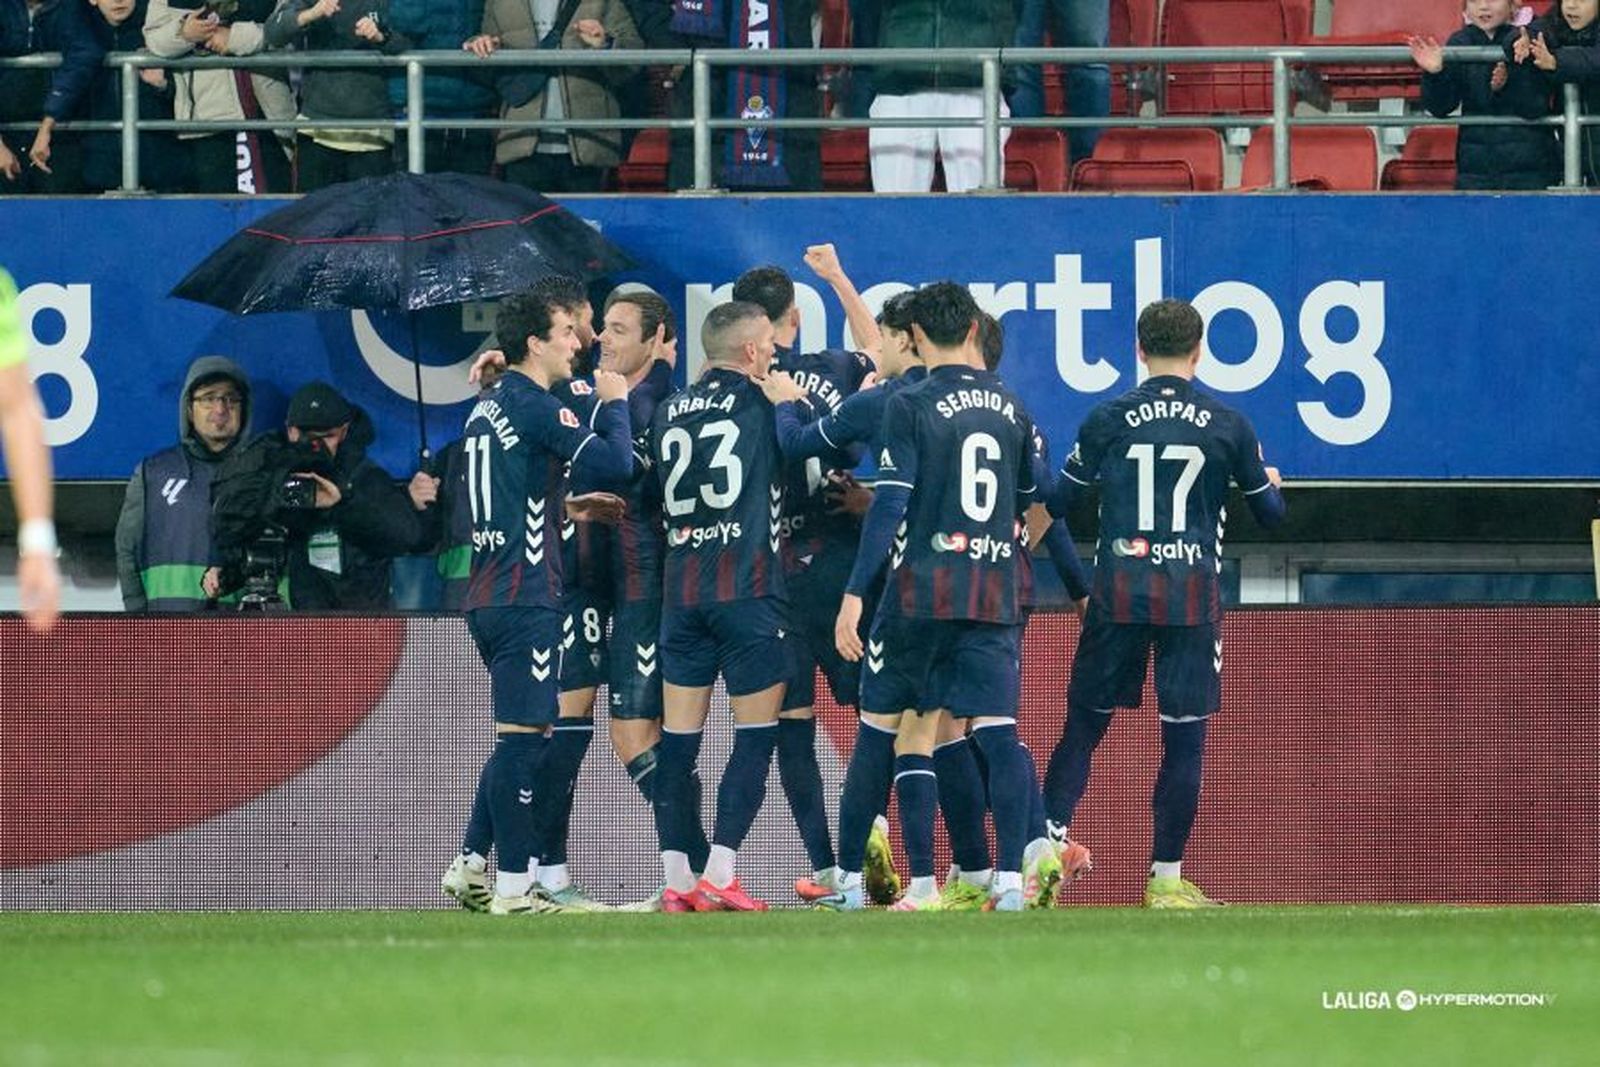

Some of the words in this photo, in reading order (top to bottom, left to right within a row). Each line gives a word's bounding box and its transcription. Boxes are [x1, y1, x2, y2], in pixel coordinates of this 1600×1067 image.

[936, 388, 1002, 419] SERGIO
[1124, 400, 1212, 428] CORPAS
[463, 434, 492, 524] 11
[660, 419, 743, 517] 23
[961, 432, 1001, 522] 6
[1125, 443, 1206, 533] 17
[582, 607, 601, 643] 8
